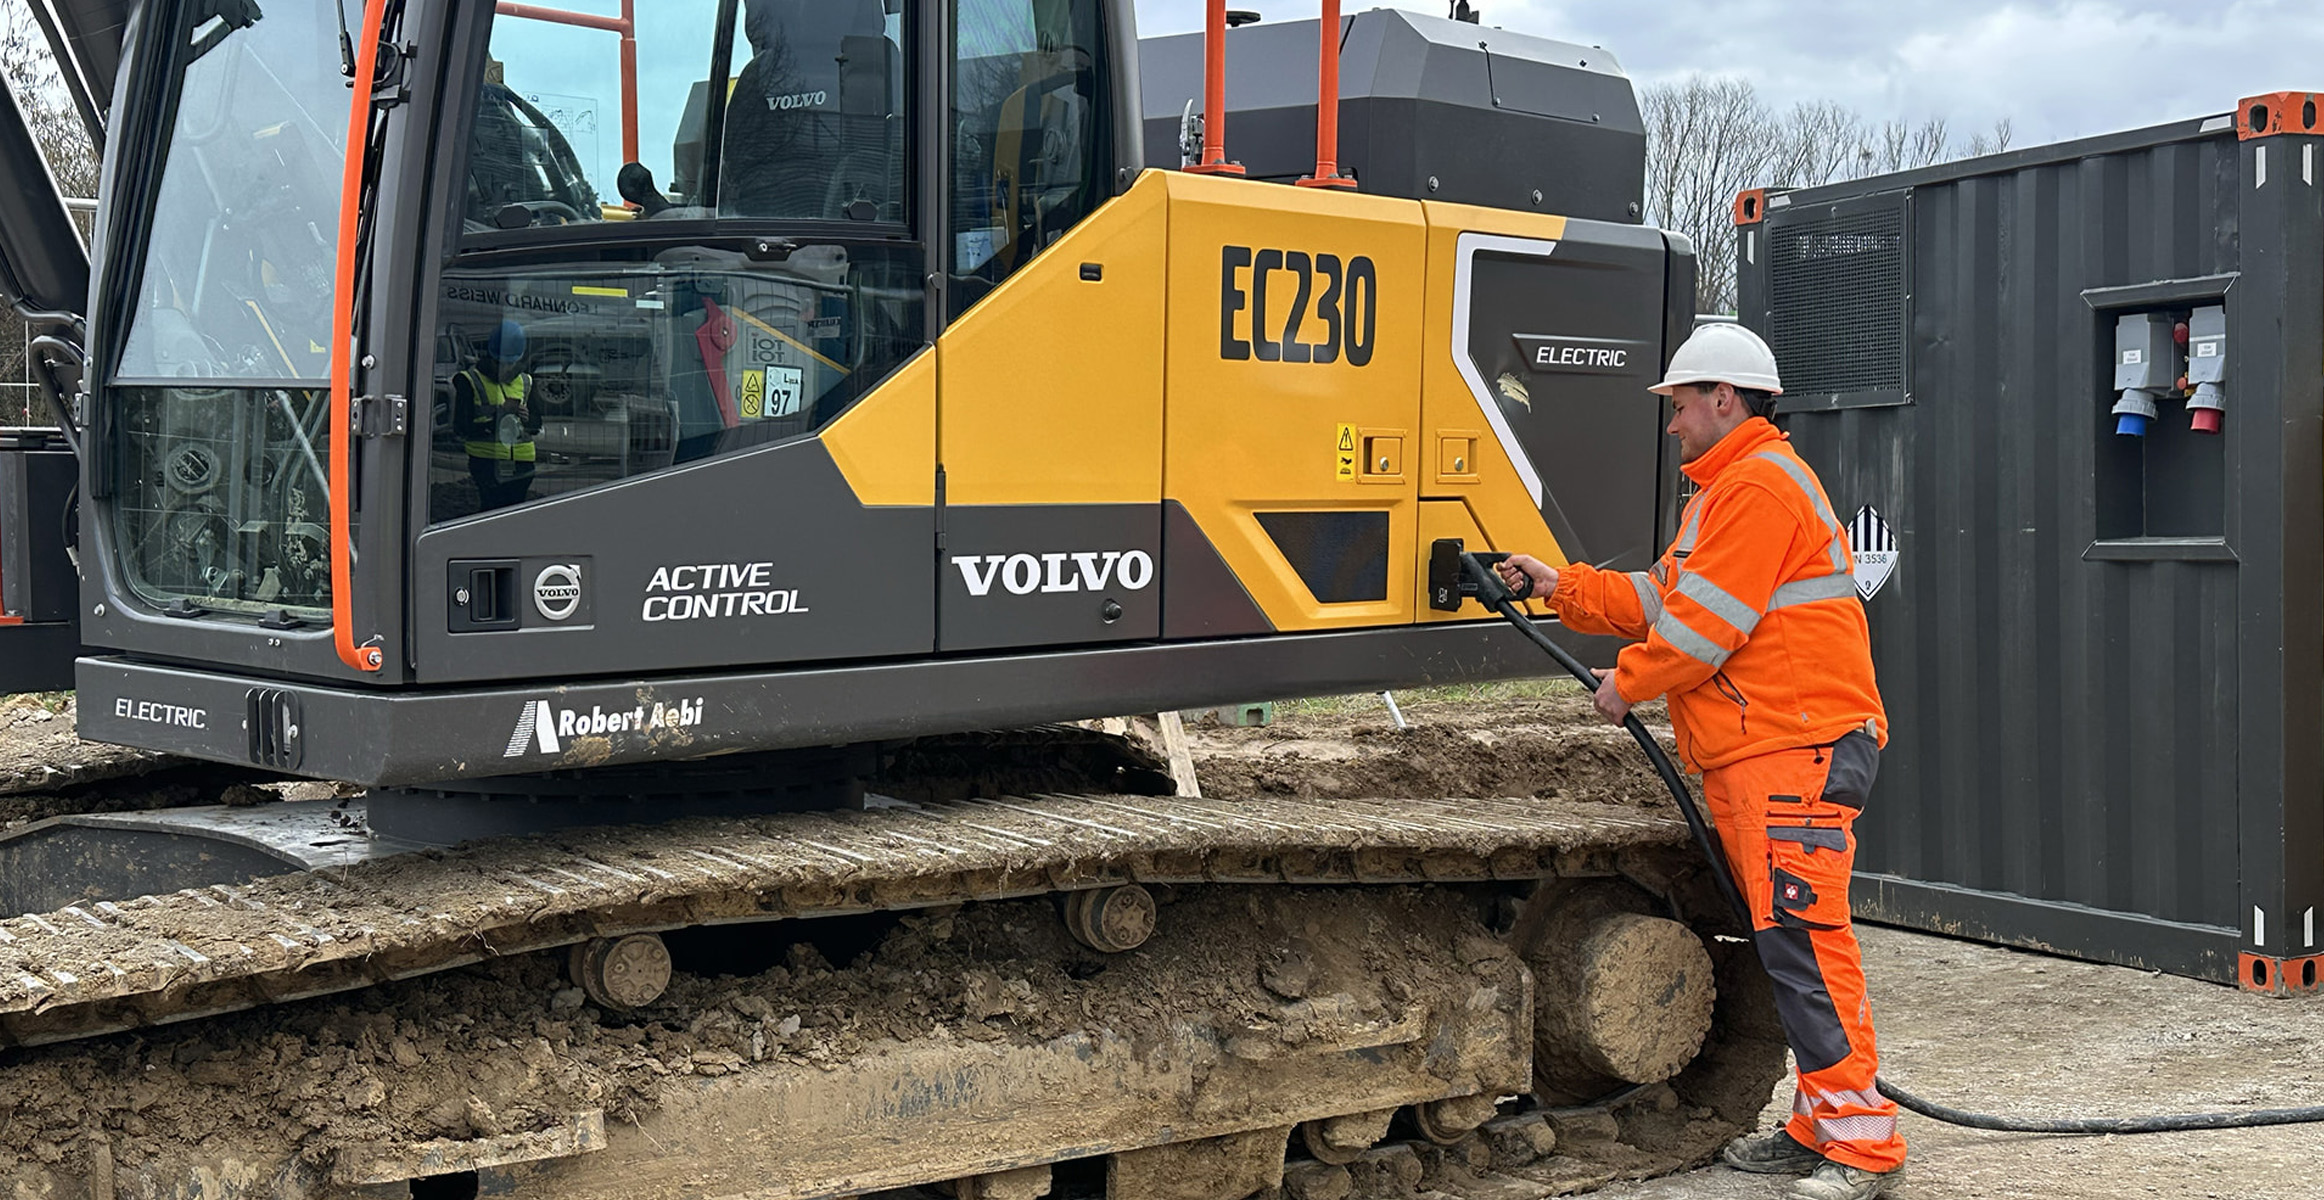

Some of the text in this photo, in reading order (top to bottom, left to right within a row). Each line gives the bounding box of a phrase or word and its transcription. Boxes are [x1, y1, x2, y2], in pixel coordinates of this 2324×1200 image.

[766, 90, 827, 111] VOLVO
[1220, 245, 1377, 367] EC230
[1536, 346, 1627, 367] ELECTRIC
[771, 388, 791, 416] 97
[645, 562, 773, 593] ACTIVE
[951, 550, 1154, 597] VOLVO
[536, 585, 579, 600] VOLVO
[642, 589, 809, 622] CONTROL
[115, 698, 206, 729] ELECTRIC
[558, 705, 644, 737] Robert
